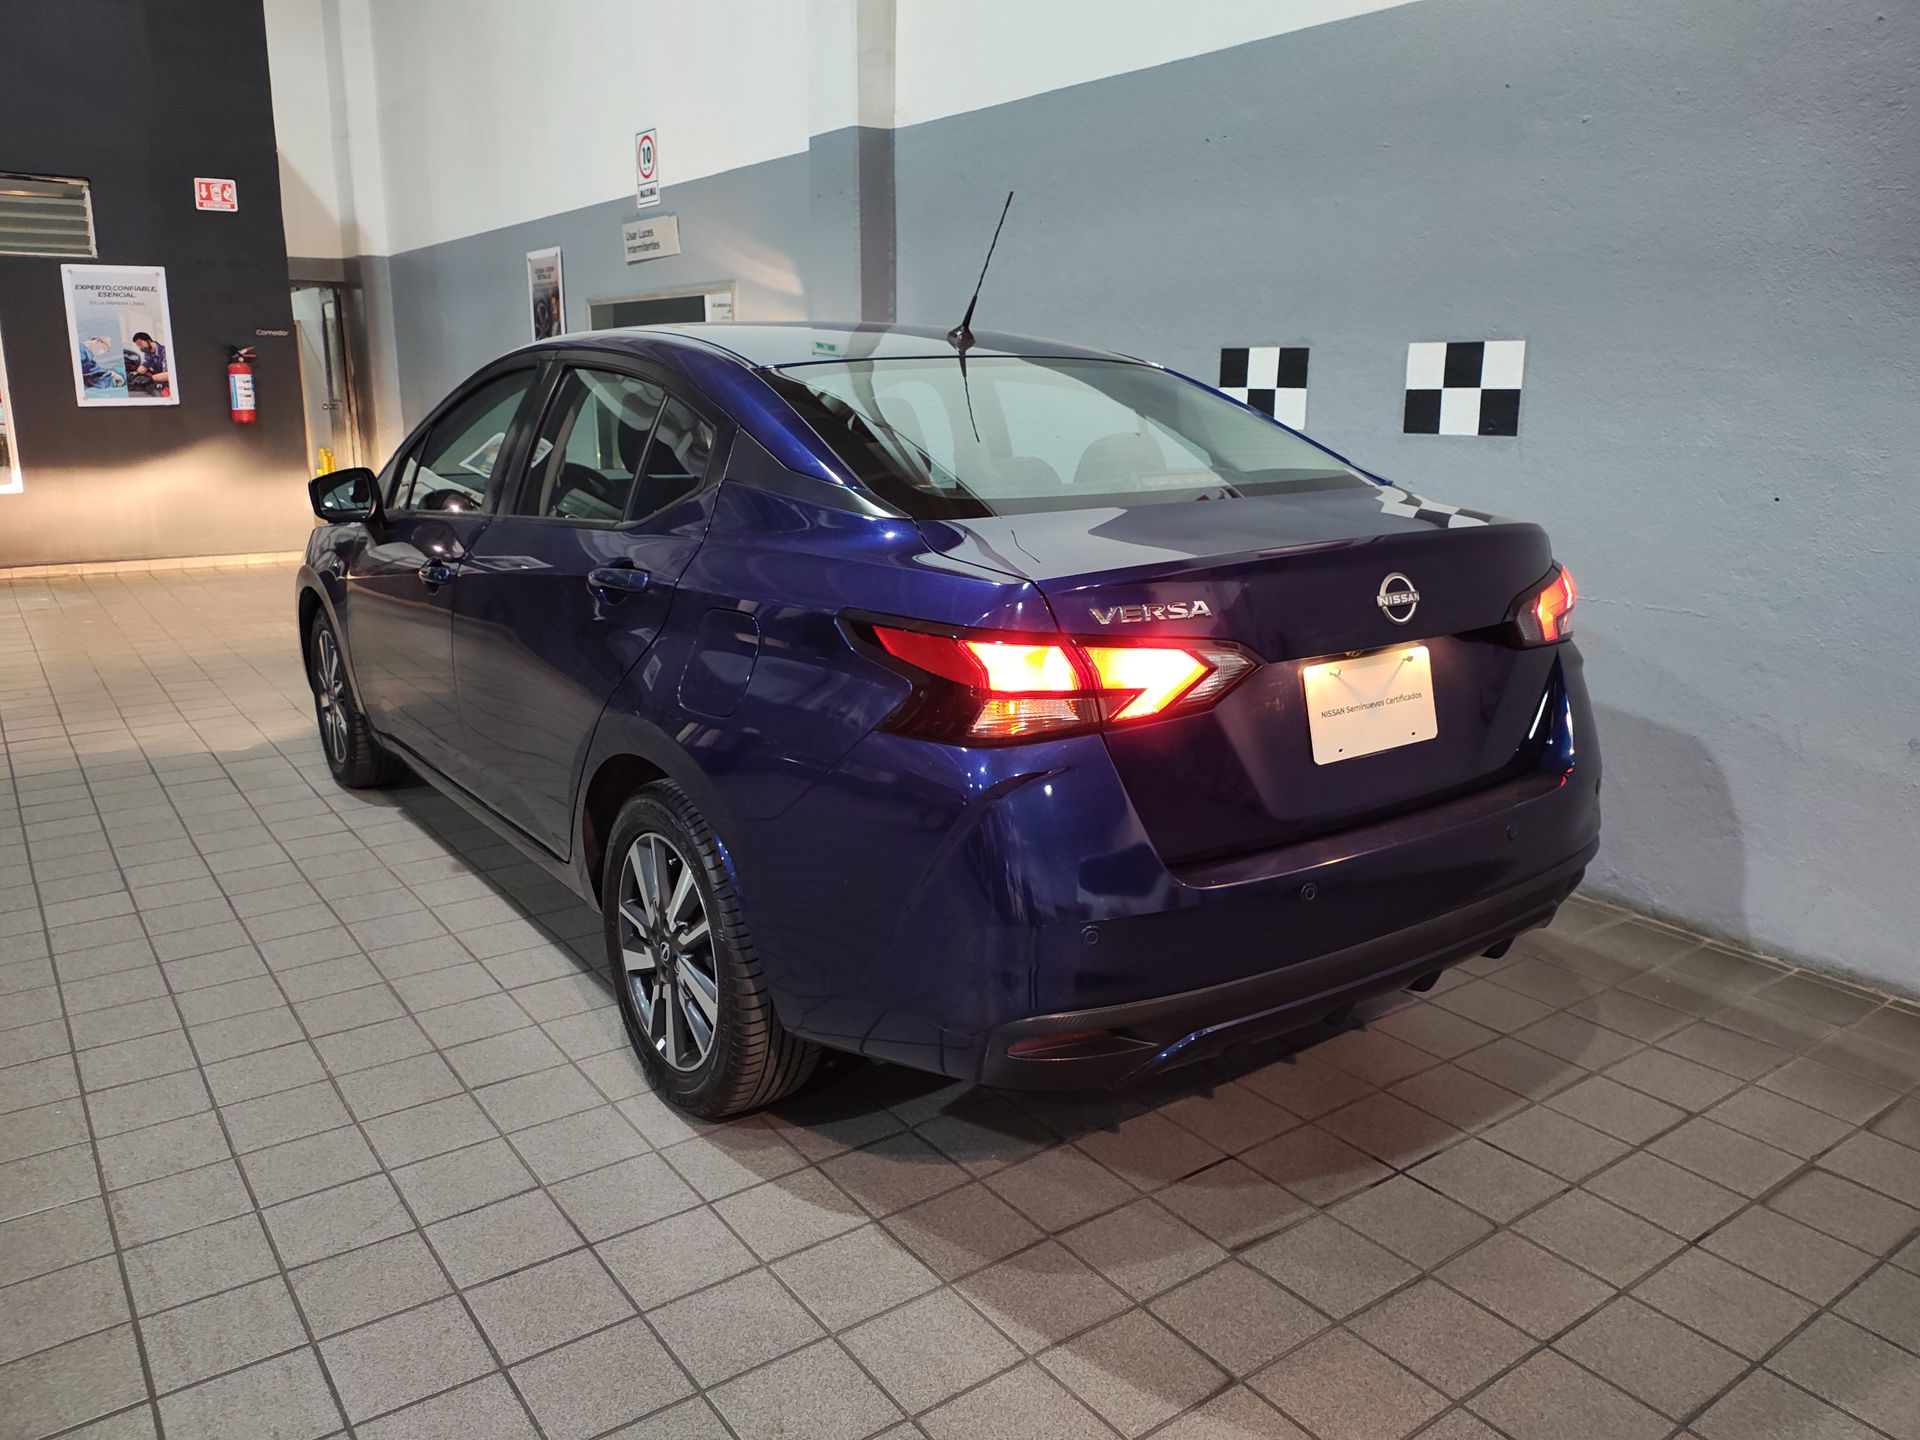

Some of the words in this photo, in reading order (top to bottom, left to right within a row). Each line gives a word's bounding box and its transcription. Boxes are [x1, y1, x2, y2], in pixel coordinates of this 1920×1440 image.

[642, 146, 652, 165] 10
[639, 228, 654, 239] Luces
[1379, 592, 1419, 607] NISSAN
[1089, 600, 1212, 625] VERSA
[1321, 706, 1345, 718] NISSAN
[1346, 700, 1385, 713] Seminuevos
[1385, 692, 1422, 706] Certificados
